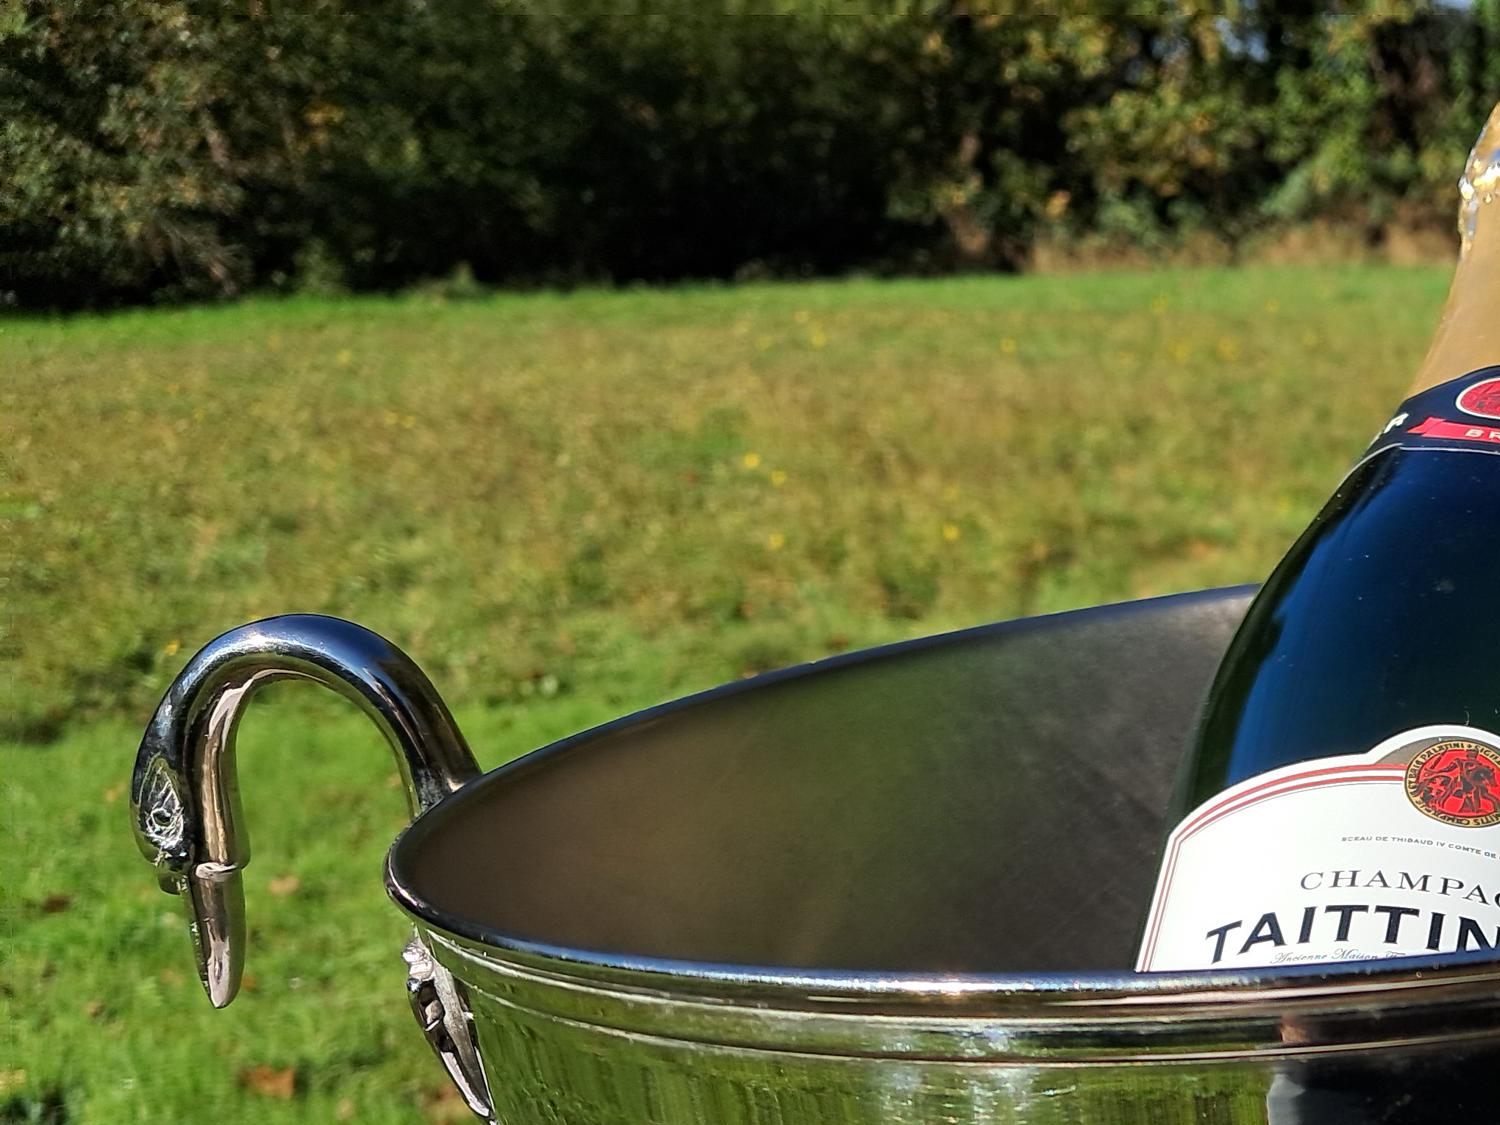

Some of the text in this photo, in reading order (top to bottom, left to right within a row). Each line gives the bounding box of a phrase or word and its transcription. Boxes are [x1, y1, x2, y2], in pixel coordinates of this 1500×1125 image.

[1391, 837, 1434, 846] THIBAUD
[1448, 843, 1481, 855] COMTE
[1484, 851, 1497, 859] DE
